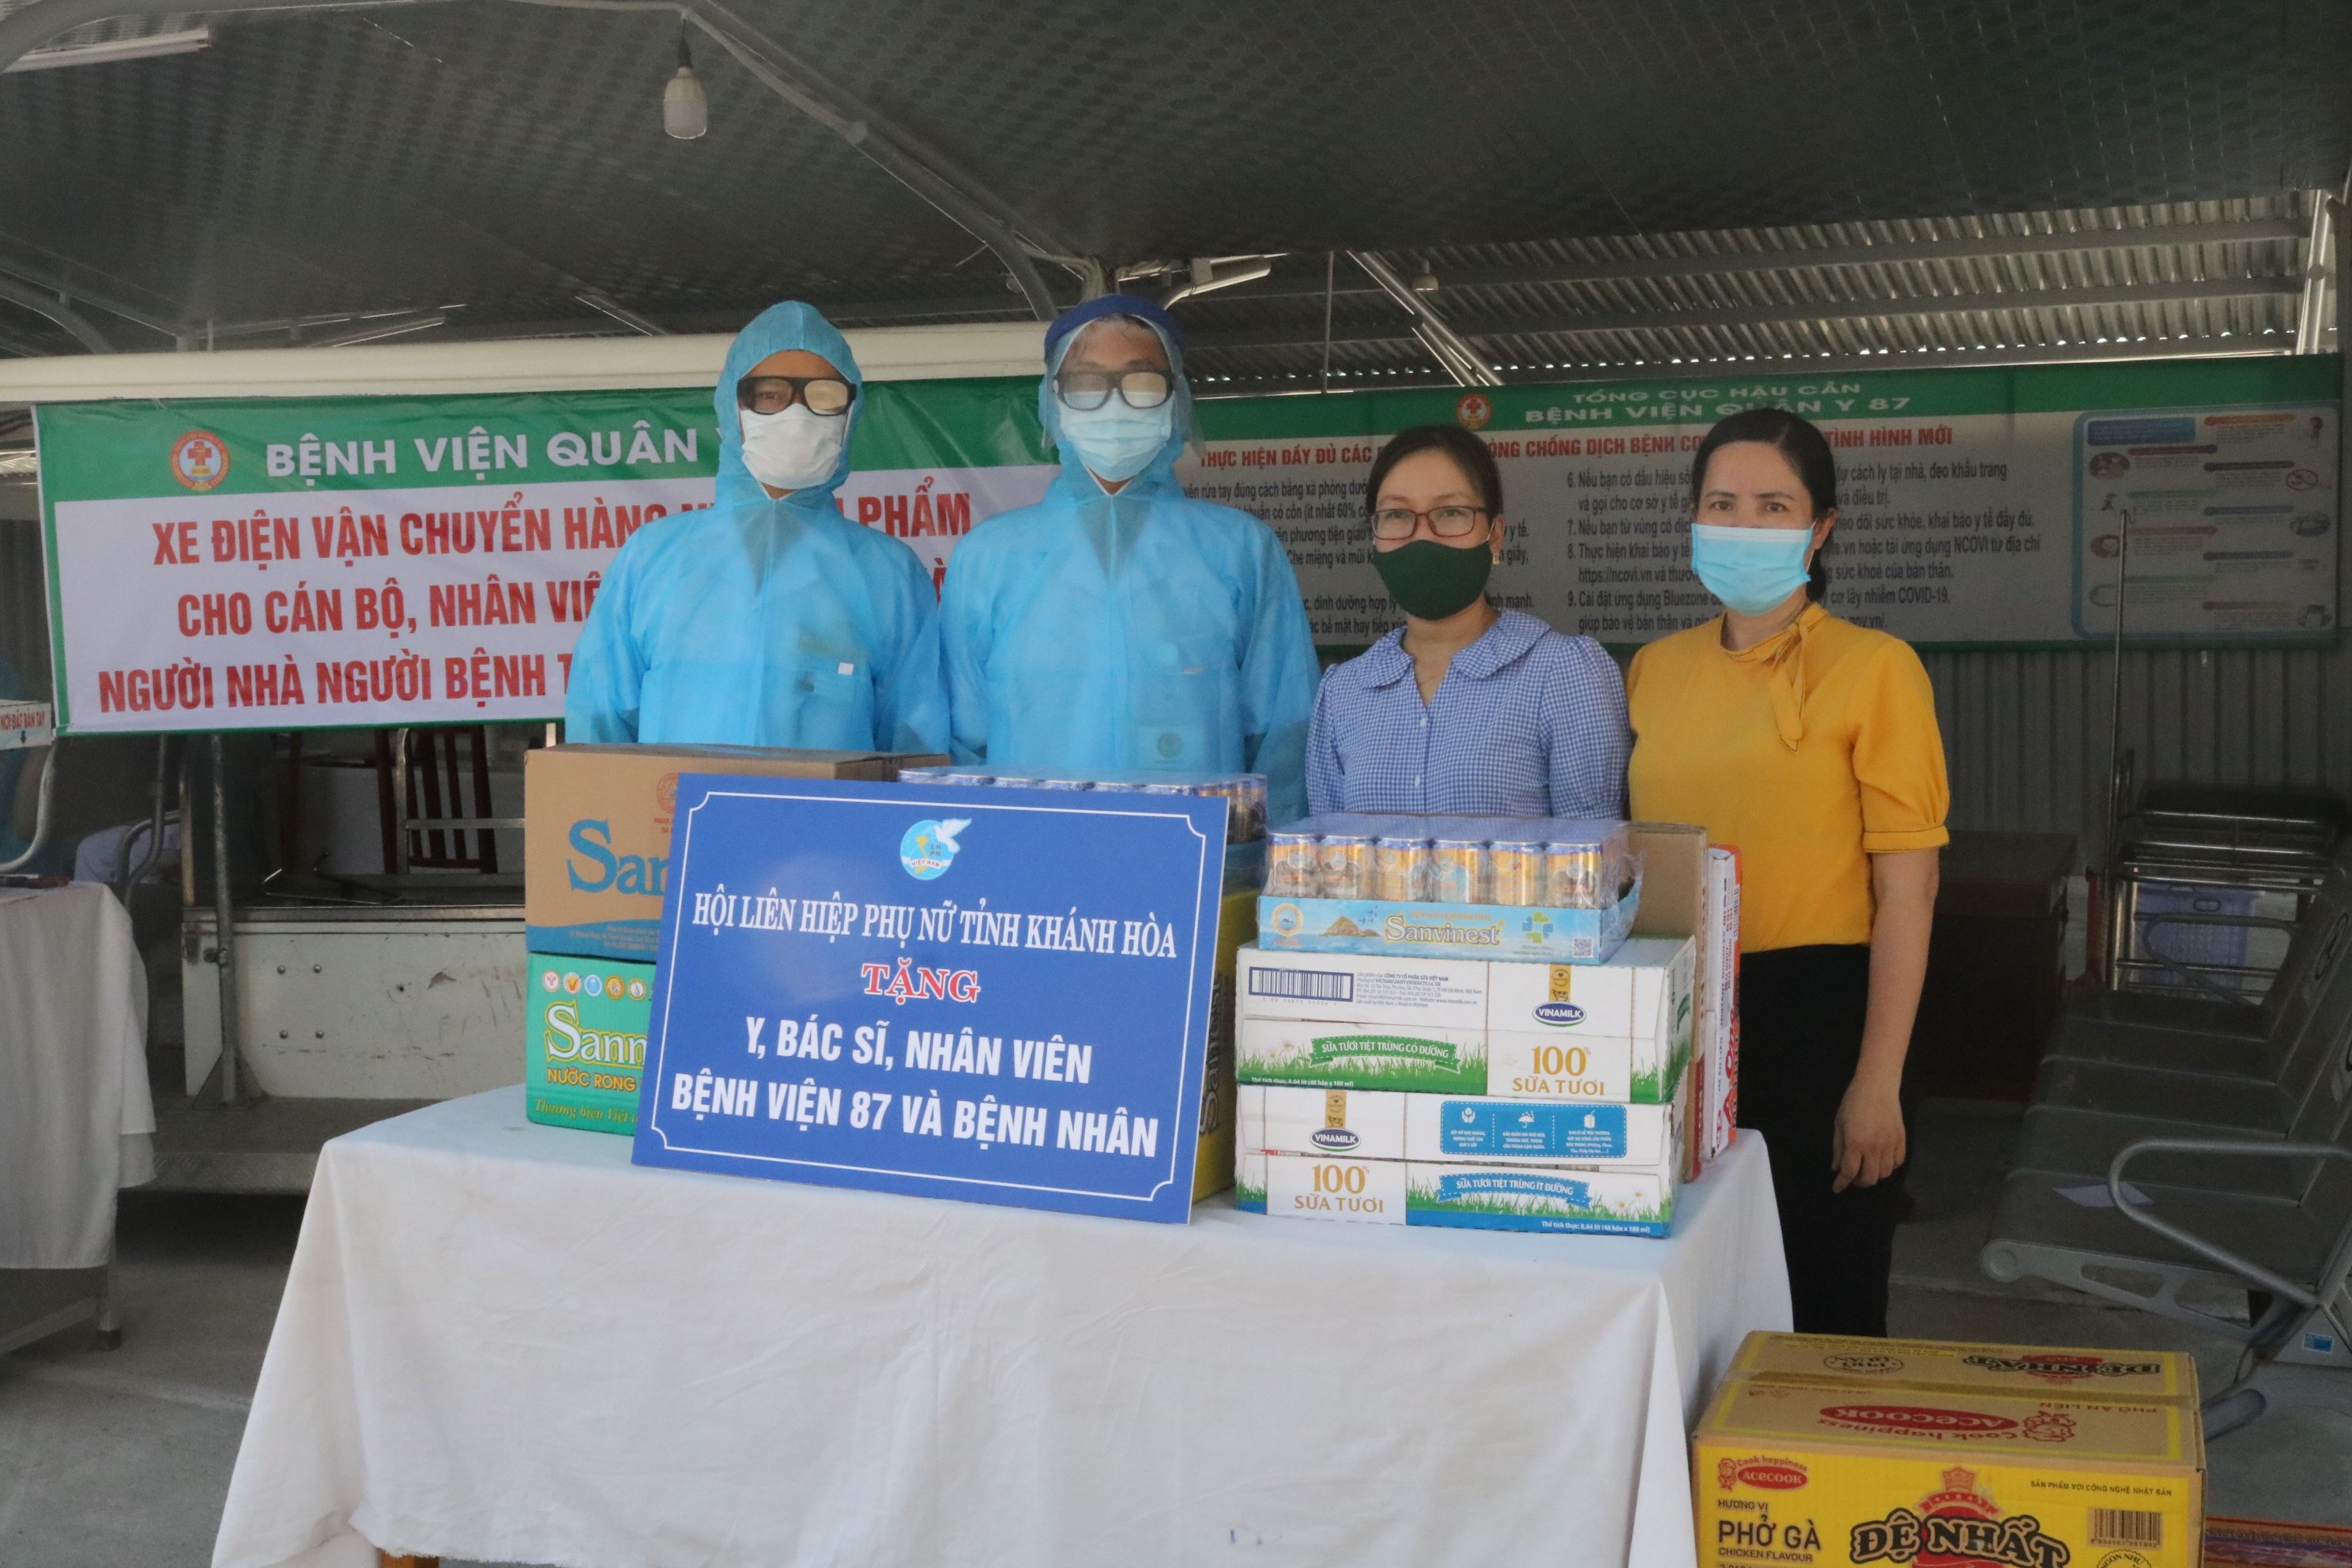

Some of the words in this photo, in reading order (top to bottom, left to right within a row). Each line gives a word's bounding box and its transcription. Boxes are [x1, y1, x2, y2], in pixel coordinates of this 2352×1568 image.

[1574, 389, 1649, 403] TỔNG
[1659, 390, 1719, 401] CỤC
[1730, 385, 1788, 399] HẬU
[1525, 406, 1612, 424] BỆNH
[1626, 403, 1702, 420] VIỆN
[1835, 398, 1856, 412] Y
[1868, 398, 1911, 410] 87
[266, 432, 396, 486] BỆNH
[413, 426, 528, 480] VIỆN
[547, 420, 699, 468] QUÂN
[1200, 450, 1237, 470] THỰC
[1242, 447, 1277, 469] HIỆN
[1282, 443, 1311, 466] ĐẦY
[1315, 443, 1336, 464] ĐỦ
[1341, 443, 1372, 463] CÁC
[1525, 434, 1581, 457] CHỐNG
[1586, 438, 1625, 458] DỊCH
[1630, 433, 1675, 457] BỆNH
[1825, 428, 1864, 449] TÌNH
[1870, 426, 1913, 447] HÌNH
[1918, 424, 1953, 446] MỚI
[1568, 472, 1576, 488] 6.
[1578, 468, 1596, 488] Nếu
[1600, 471, 1618, 491] bạn
[1655, 469, 1675, 489] hiệu
[1851, 462, 1875, 481] cách
[1930, 462, 1948, 479] đeo
[1980, 462, 2007, 482] trang
[1219, 485, 1232, 502] tay
[1318, 481, 1344, 499] phòng
[152, 521, 200, 566] XE
[211, 509, 300, 571] ĐIỆN
[311, 506, 386, 567] VẬN
[400, 490, 552, 556] CHUYỂN
[564, 496, 666, 549] HÀN
[858, 476, 971, 537] PHẨM
[1337, 504, 1357, 518] 60%
[1578, 515, 1596, 536] Nếu
[1600, 519, 1618, 540] bạn
[1928, 511, 1950, 530] khai
[1953, 511, 1973, 528] báo
[1568, 543, 1576, 560] 8.
[1578, 542, 1604, 562] Thực
[1606, 541, 1627, 563] hiện
[1630, 541, 1649, 558] khai
[1859, 539, 1883, 559] hoặc
[1924, 538, 1951, 558] dụng
[1954, 536, 1988, 553] NCOVI
[178, 592, 252, 637] CHO
[264, 581, 341, 633] CÁN
[355, 578, 416, 639] BỘ,
[429, 574, 537, 628] NHÂN
[1568, 590, 1576, 607] 9.
[1578, 590, 1595, 607] Cài
[1636, 590, 1660, 610] dụng
[1663, 589, 1708, 606] Bluezone
[1864, 584, 1896, 604] nhiễm
[99, 656, 215, 714] NGƯỜI
[227, 653, 306, 707] NHÀ
[316, 648, 432, 703] NGƯỜI
[445, 647, 545, 707] BỆNH
[692, 883, 738, 936] HỘI
[739, 887, 797, 932] LIÊN
[799, 890, 859, 944] HIỆP
[861, 906, 914, 948] PHỤ
[918, 900, 958, 943] NỮ
[959, 897, 1020, 948] TỈNH
[1024, 906, 1116, 954] KHÁNH
[1121, 911, 1178, 959] HÒA
[1385, 914, 1501, 945] Sanvinest
[861, 957, 982, 1006] TẶNG
[1538, 1008, 1581, 1019] VINAMILK
[745, 1016, 766, 1061] Y,
[776, 1014, 842, 1062] BÁC
[853, 1020, 893, 1072] SĨ,
[906, 1027, 1001, 1077] NHÂN
[1012, 1035, 1092, 1084] VIÊN
[1321, 1040, 1338, 1053] SỮA
[1339, 1040, 1359, 1051] TƯƠI
[1377, 1039, 1404, 1053] TRÙNG
[1406, 1042, 1418, 1054] CÓ
[1419, 1044, 1449, 1058] ĐƯỜNG
[546, 1067, 590, 1087] NƯỚC
[594, 1074, 637, 1091] RONG
[1512, 1075, 1551, 1094] SỮA
[1555, 1078, 1605, 1097] TƯƠI
[671, 1068, 757, 1121] BỆNH
[768, 1078, 842, 1133] VIỆN
[850, 1090, 892, 1132] 87
[902, 1090, 943, 1137] VÀ
[953, 1095, 1046, 1150] BỆNH
[1056, 1107, 1159, 1159] NHÂN
[1314, 1133, 1358, 1144] VINAMILK
[1456, 1177, 1472, 1189] SỮA
[1473, 1178, 1491, 1188] TƯƠI
[1509, 1178, 1536, 1190] TRÙNG
[1536, 1180, 1544, 1191] ÍT
[1544, 1182, 1574, 1195] ĐƯỜNG
[1295, 1192, 1332, 1211] SỮA
[1336, 1197, 1384, 1214] TƯƠI
[1817, 1419, 1943, 1441] happiness
[1952, 1431, 2018, 1441] Cook
[1737, 1455, 1759, 1467] Cook
[1762, 1455, 1807, 1472] happiness
[2030, 1479, 2046, 1489] SẢN
[2048, 1479, 2069, 1491] PHẨM
[2071, 1482, 2084, 1491] VỚI
[2086, 1482, 2108, 1492] CÔNG
[2109, 1483, 2130, 1494] NGHỆ
[2133, 1485, 2154, 1496] NHẬT
[2155, 1486, 2173, 1496] BẢN
[1717, 1498, 1755, 1510] HƯƠNG
[1758, 1502, 1769, 1513] VỊ
[1717, 1514, 1777, 1547] PHỞ
[1784, 1520, 1822, 1551] GÀ
[1853, 1510, 1919, 1561] ĐỆ
[1928, 1513, 2067, 1568] NHẤT
[1718, 1547, 1764, 1559] CHICKEN
[1766, 1551, 1813, 1563] FLAVOUR
